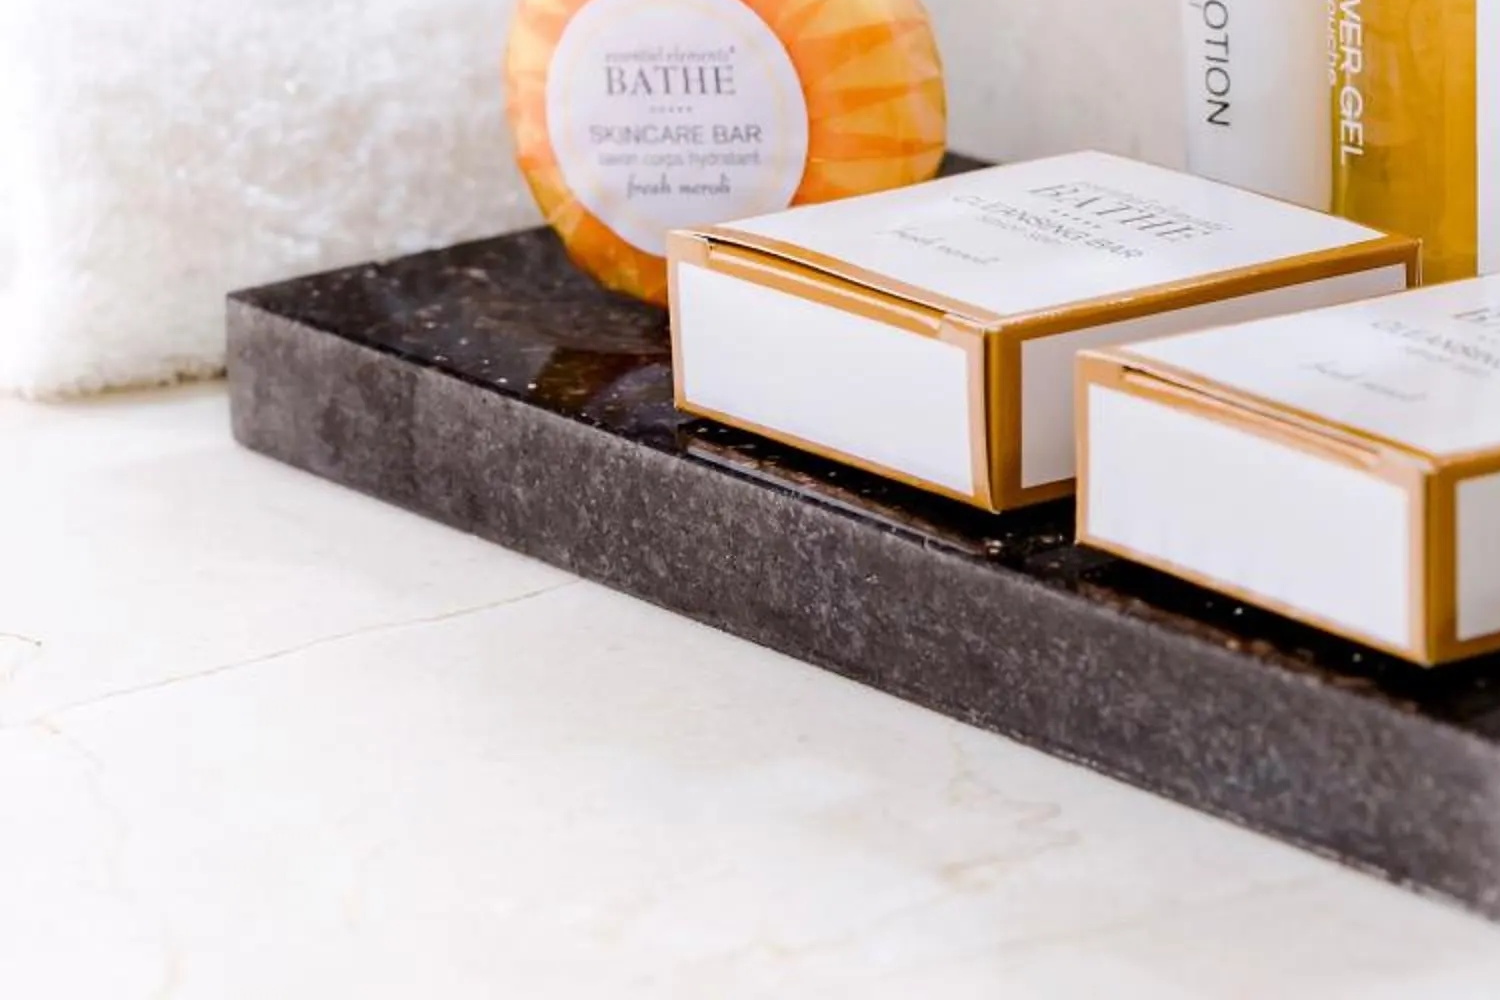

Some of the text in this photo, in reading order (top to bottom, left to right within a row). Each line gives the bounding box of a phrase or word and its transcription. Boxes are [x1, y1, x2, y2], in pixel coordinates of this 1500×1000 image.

[604, 65, 736, 96] BATHE
[588, 124, 763, 146] SKINCARE BAR
[1339, 86, 1365, 166] GEL
[626, 171, 732, 200] fresh neroli
[1029, 184, 1213, 243] BATHE
[1084, 238, 1144, 261] BAR
